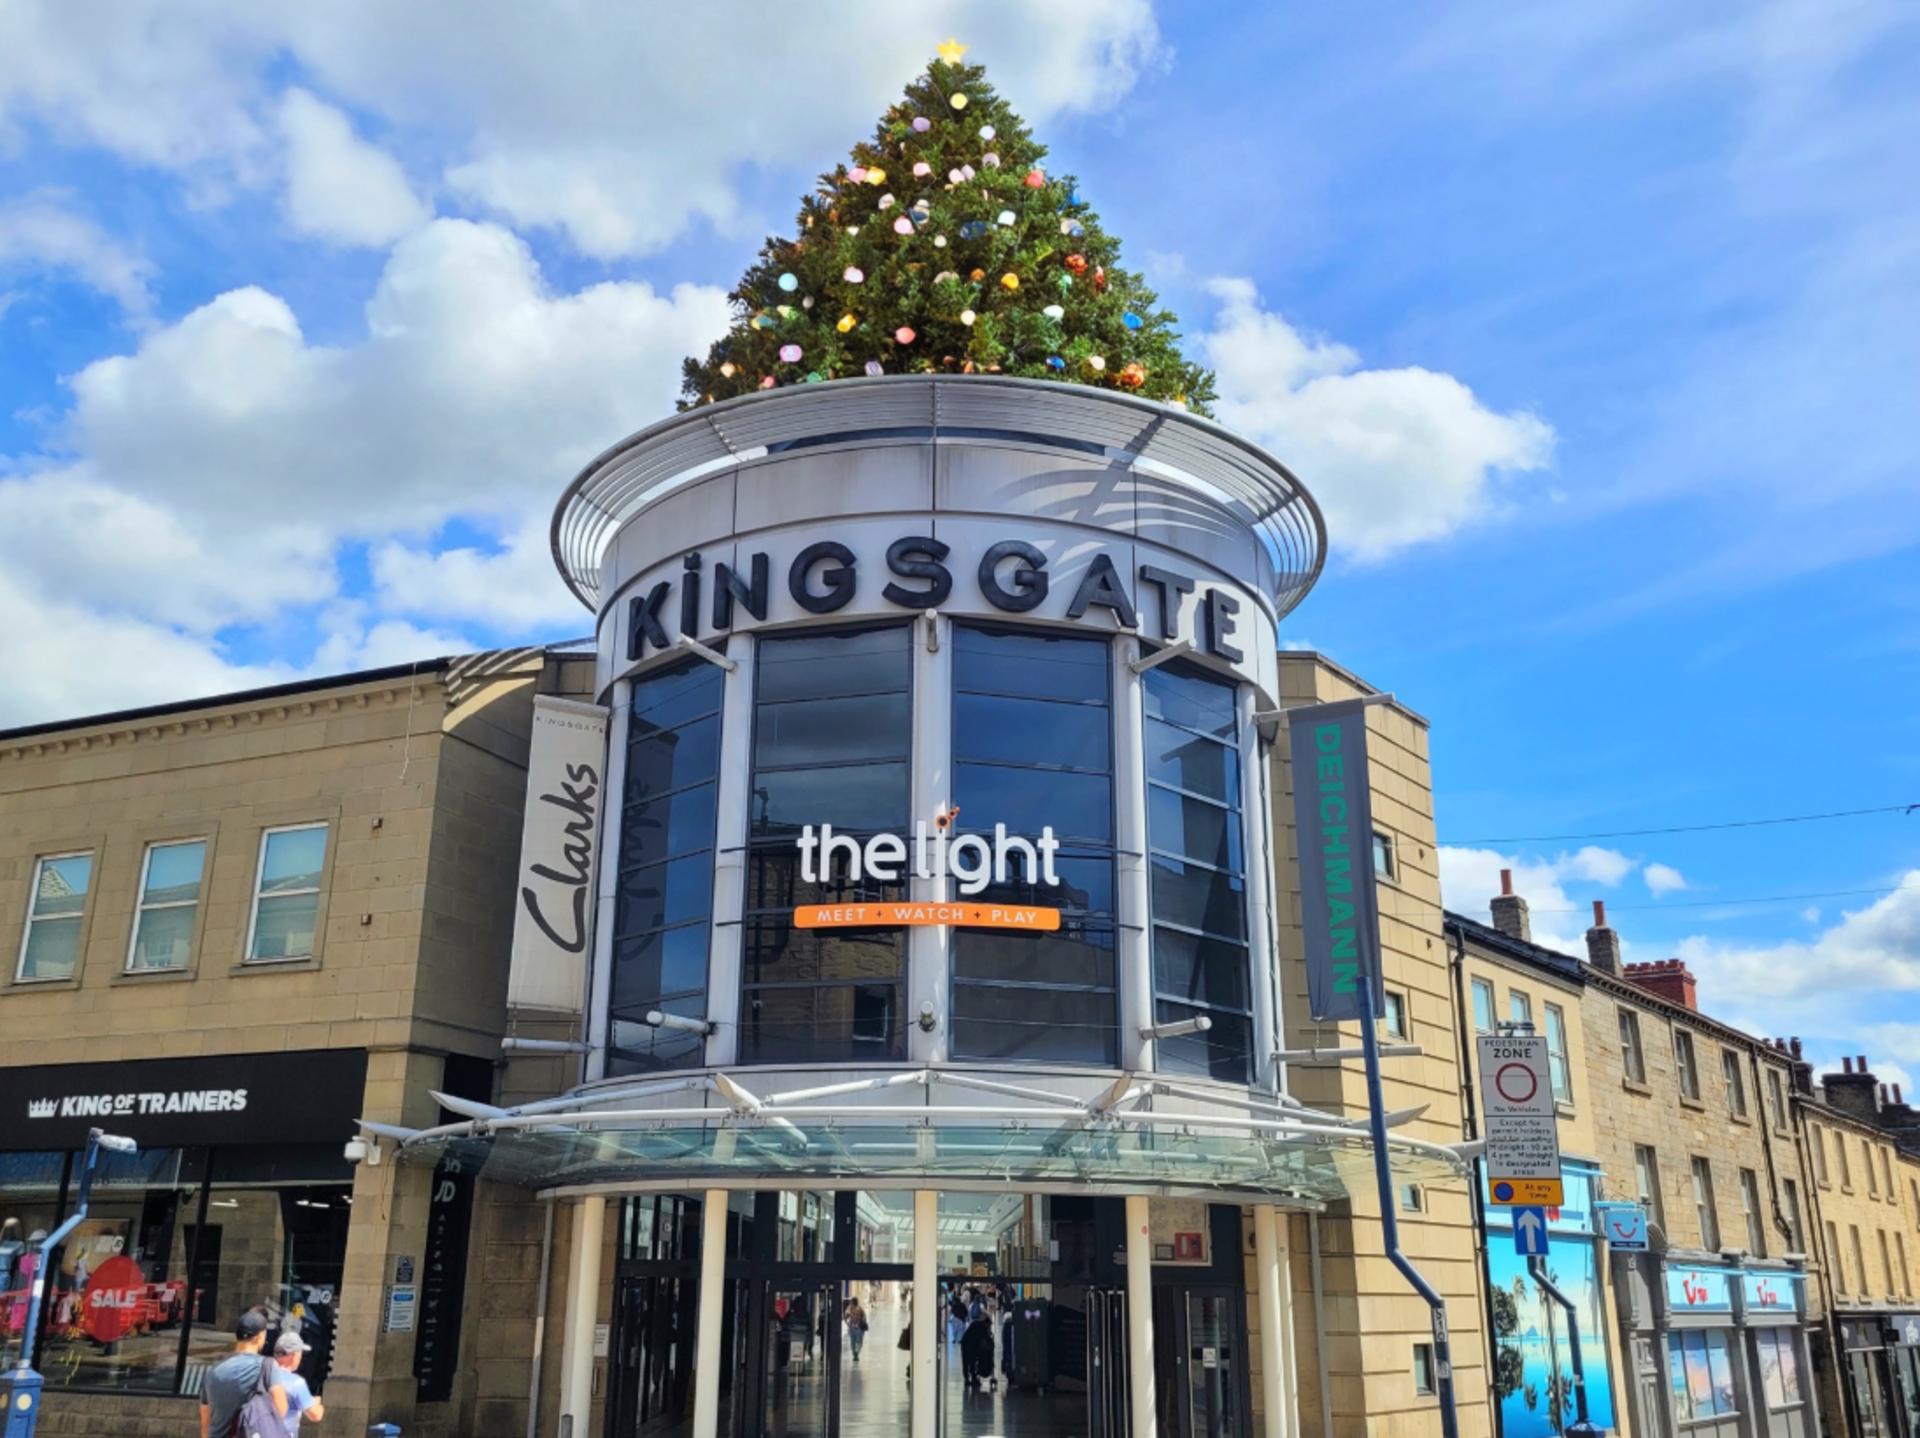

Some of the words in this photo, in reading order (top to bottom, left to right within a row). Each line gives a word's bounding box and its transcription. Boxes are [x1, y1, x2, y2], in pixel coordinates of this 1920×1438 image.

[627, 536, 1243, 664] KINGSGATE
[522, 763, 598, 953] Clarks
[1314, 723, 1359, 994] DEICHMANN
[817, 908, 865, 922] MEET
[894, 907, 964, 921] WATCH
[991, 909, 1038, 923] PLAY
[1493, 1048, 1532, 1058] ZONE
[61, 1095, 114, 1117] KING
[114, 1094, 136, 1110] OF
[138, 1089, 248, 1114] TRAINERS
[433, 1180, 456, 1202] JD
[91, 1288, 137, 1308] SALE
